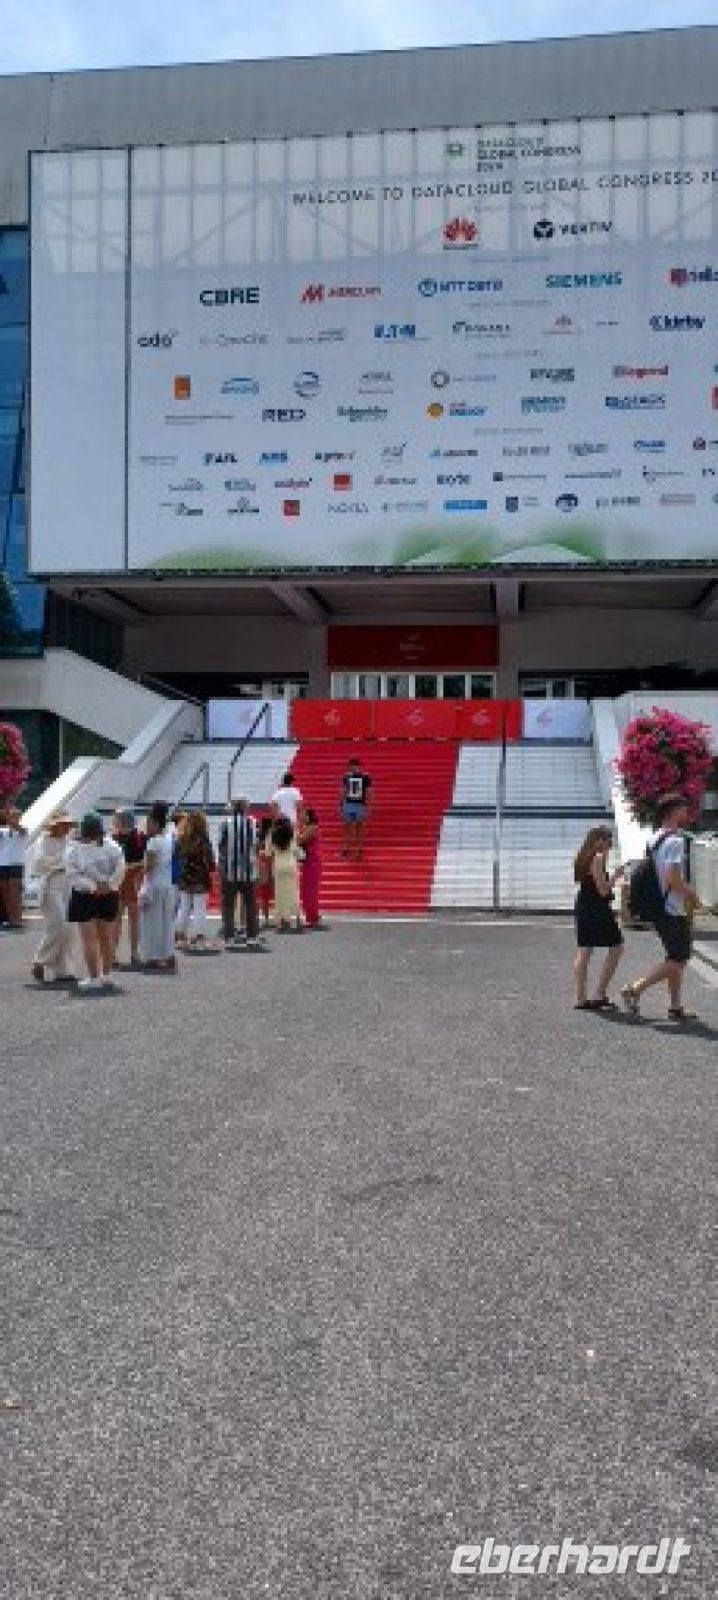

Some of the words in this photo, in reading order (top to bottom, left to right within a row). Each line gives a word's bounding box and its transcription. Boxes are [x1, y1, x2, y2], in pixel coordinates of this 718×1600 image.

[293, 187, 375, 205] WELCOME
[383, 186, 404, 201] TO
[412, 181, 513, 198] DATACLOUD
[522, 177, 590, 194] GLOBAL
[597, 171, 694, 188] CONGRESS
[546, 272, 621, 288] SIEMENS
[200, 287, 259, 306] CBRE
